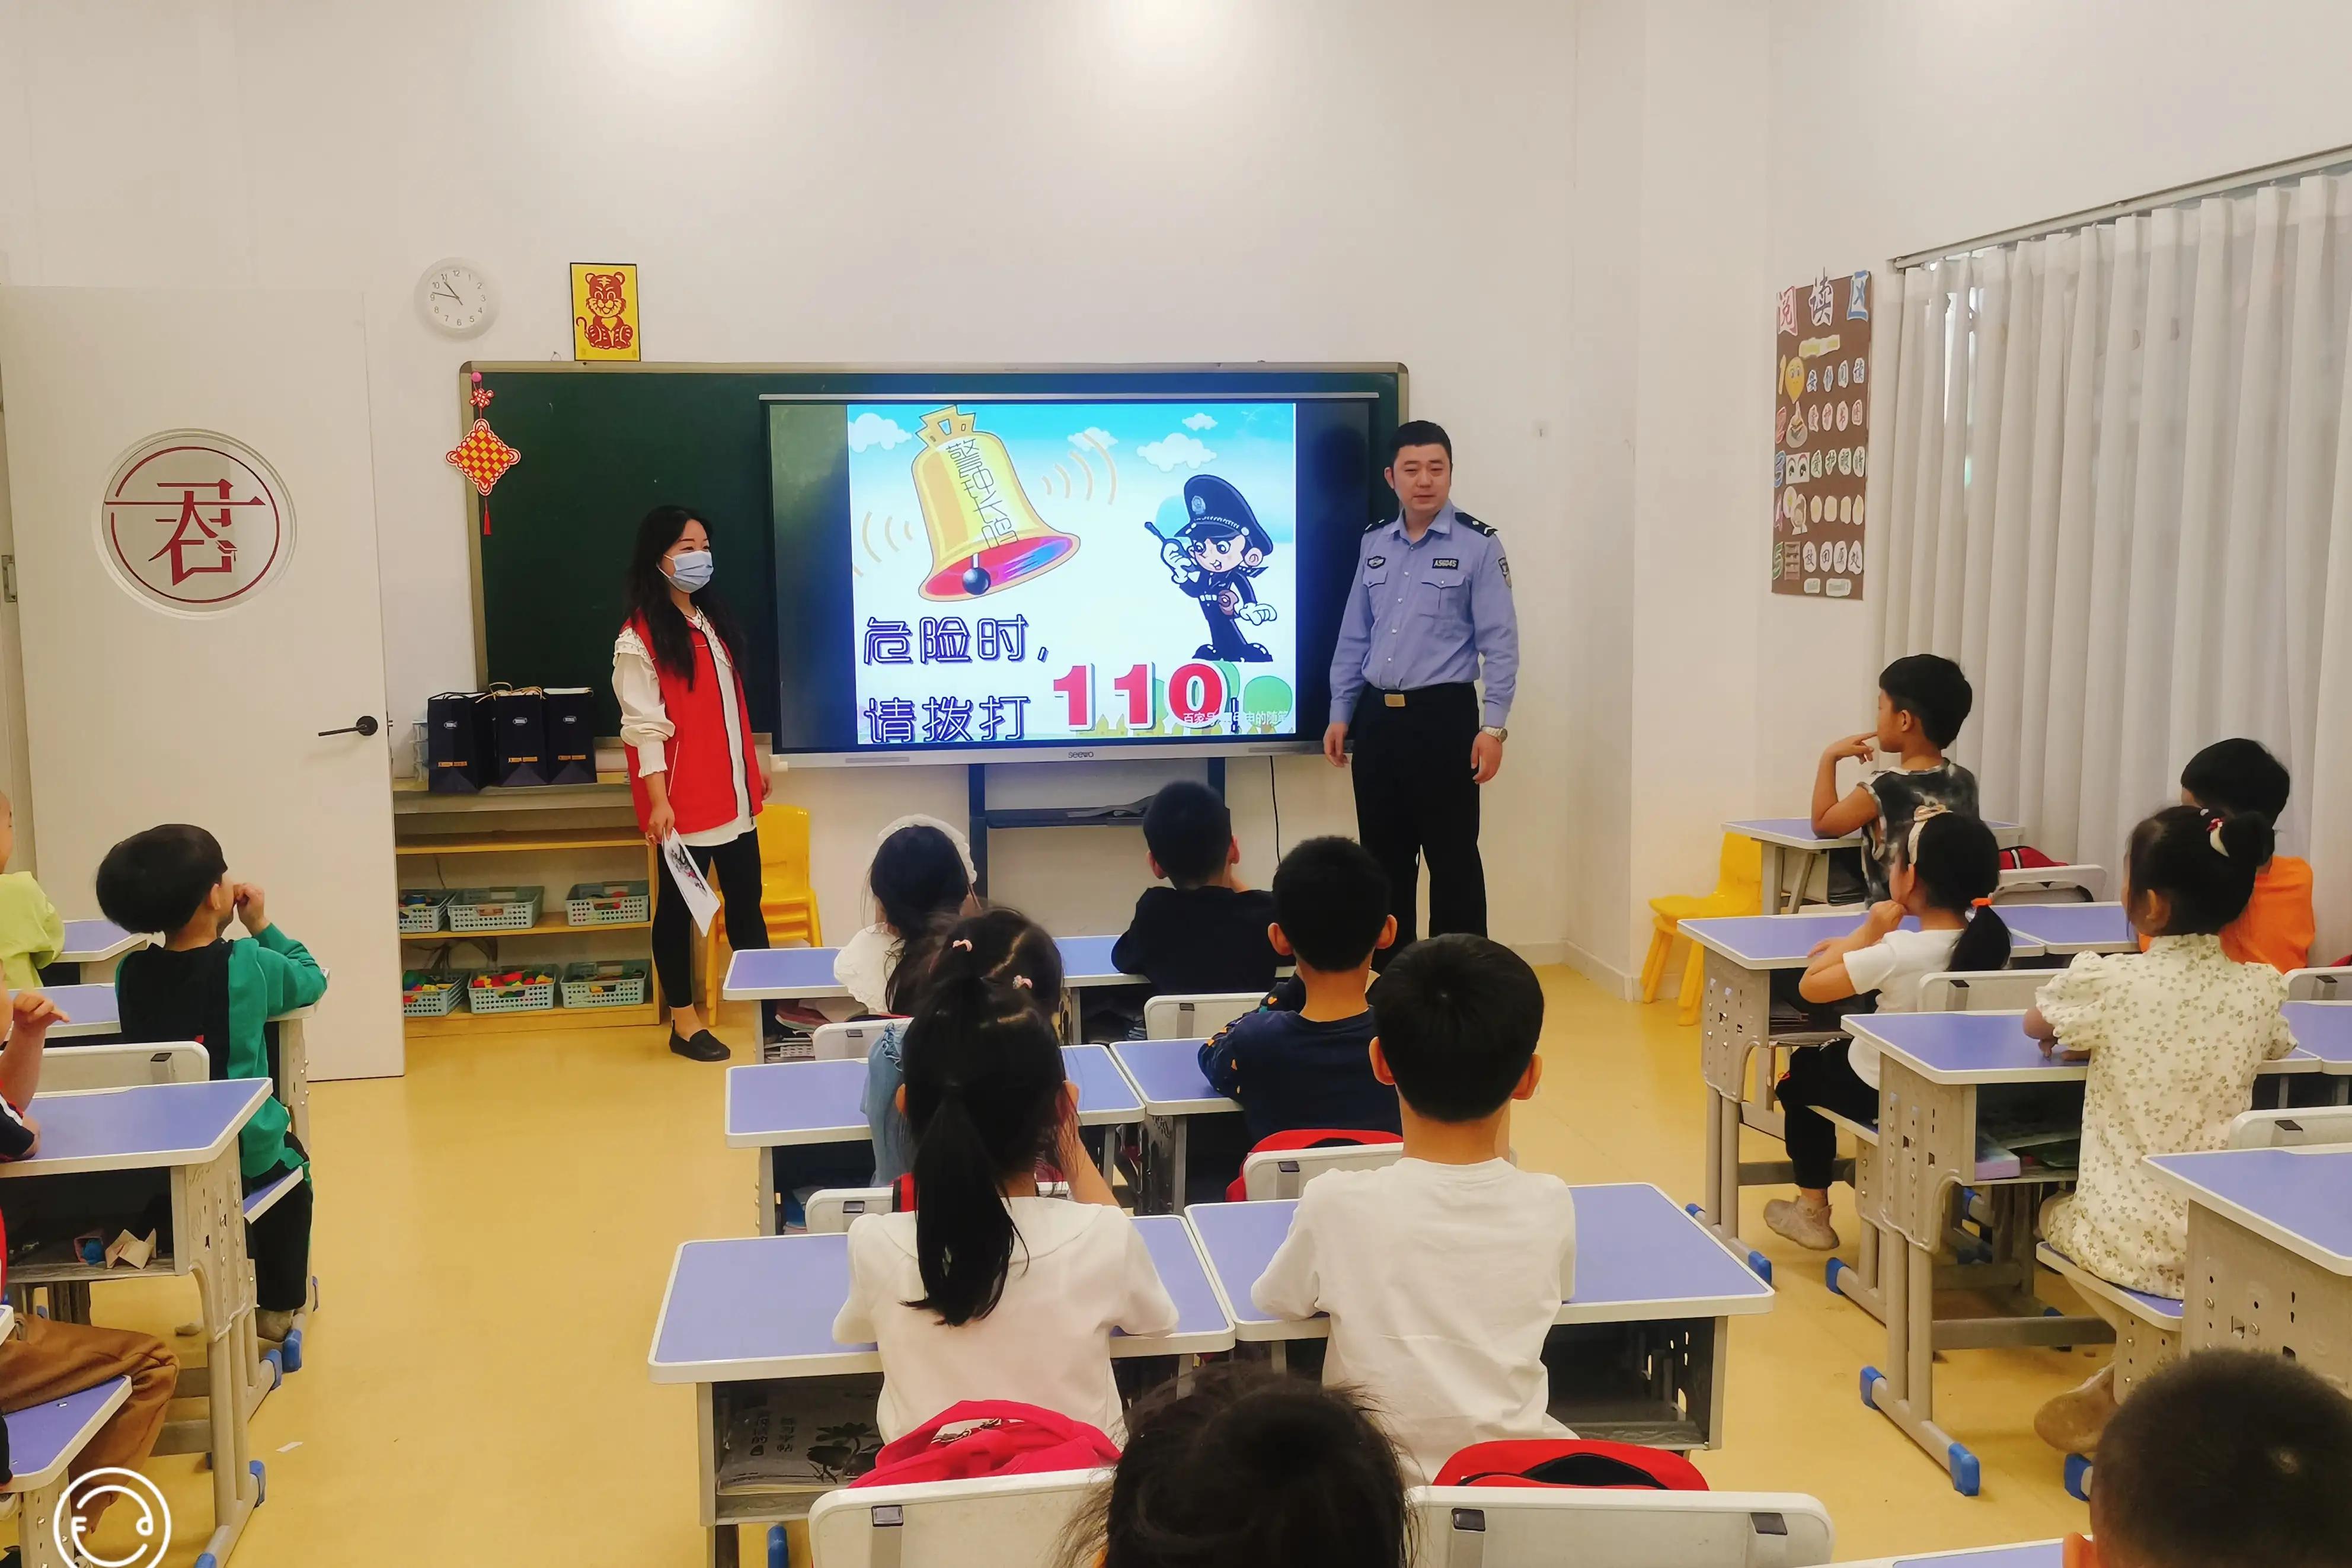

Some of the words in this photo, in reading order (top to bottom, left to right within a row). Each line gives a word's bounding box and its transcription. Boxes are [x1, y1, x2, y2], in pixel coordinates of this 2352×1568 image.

[1776, 267, 1868, 334] 阅读区
[945, 437, 1019, 549] 警钟长鸣
[1773, 450, 1786, 488] 3
[1772, 541, 1784, 581] 5
[864, 695, 1031, 743] 请拨打
